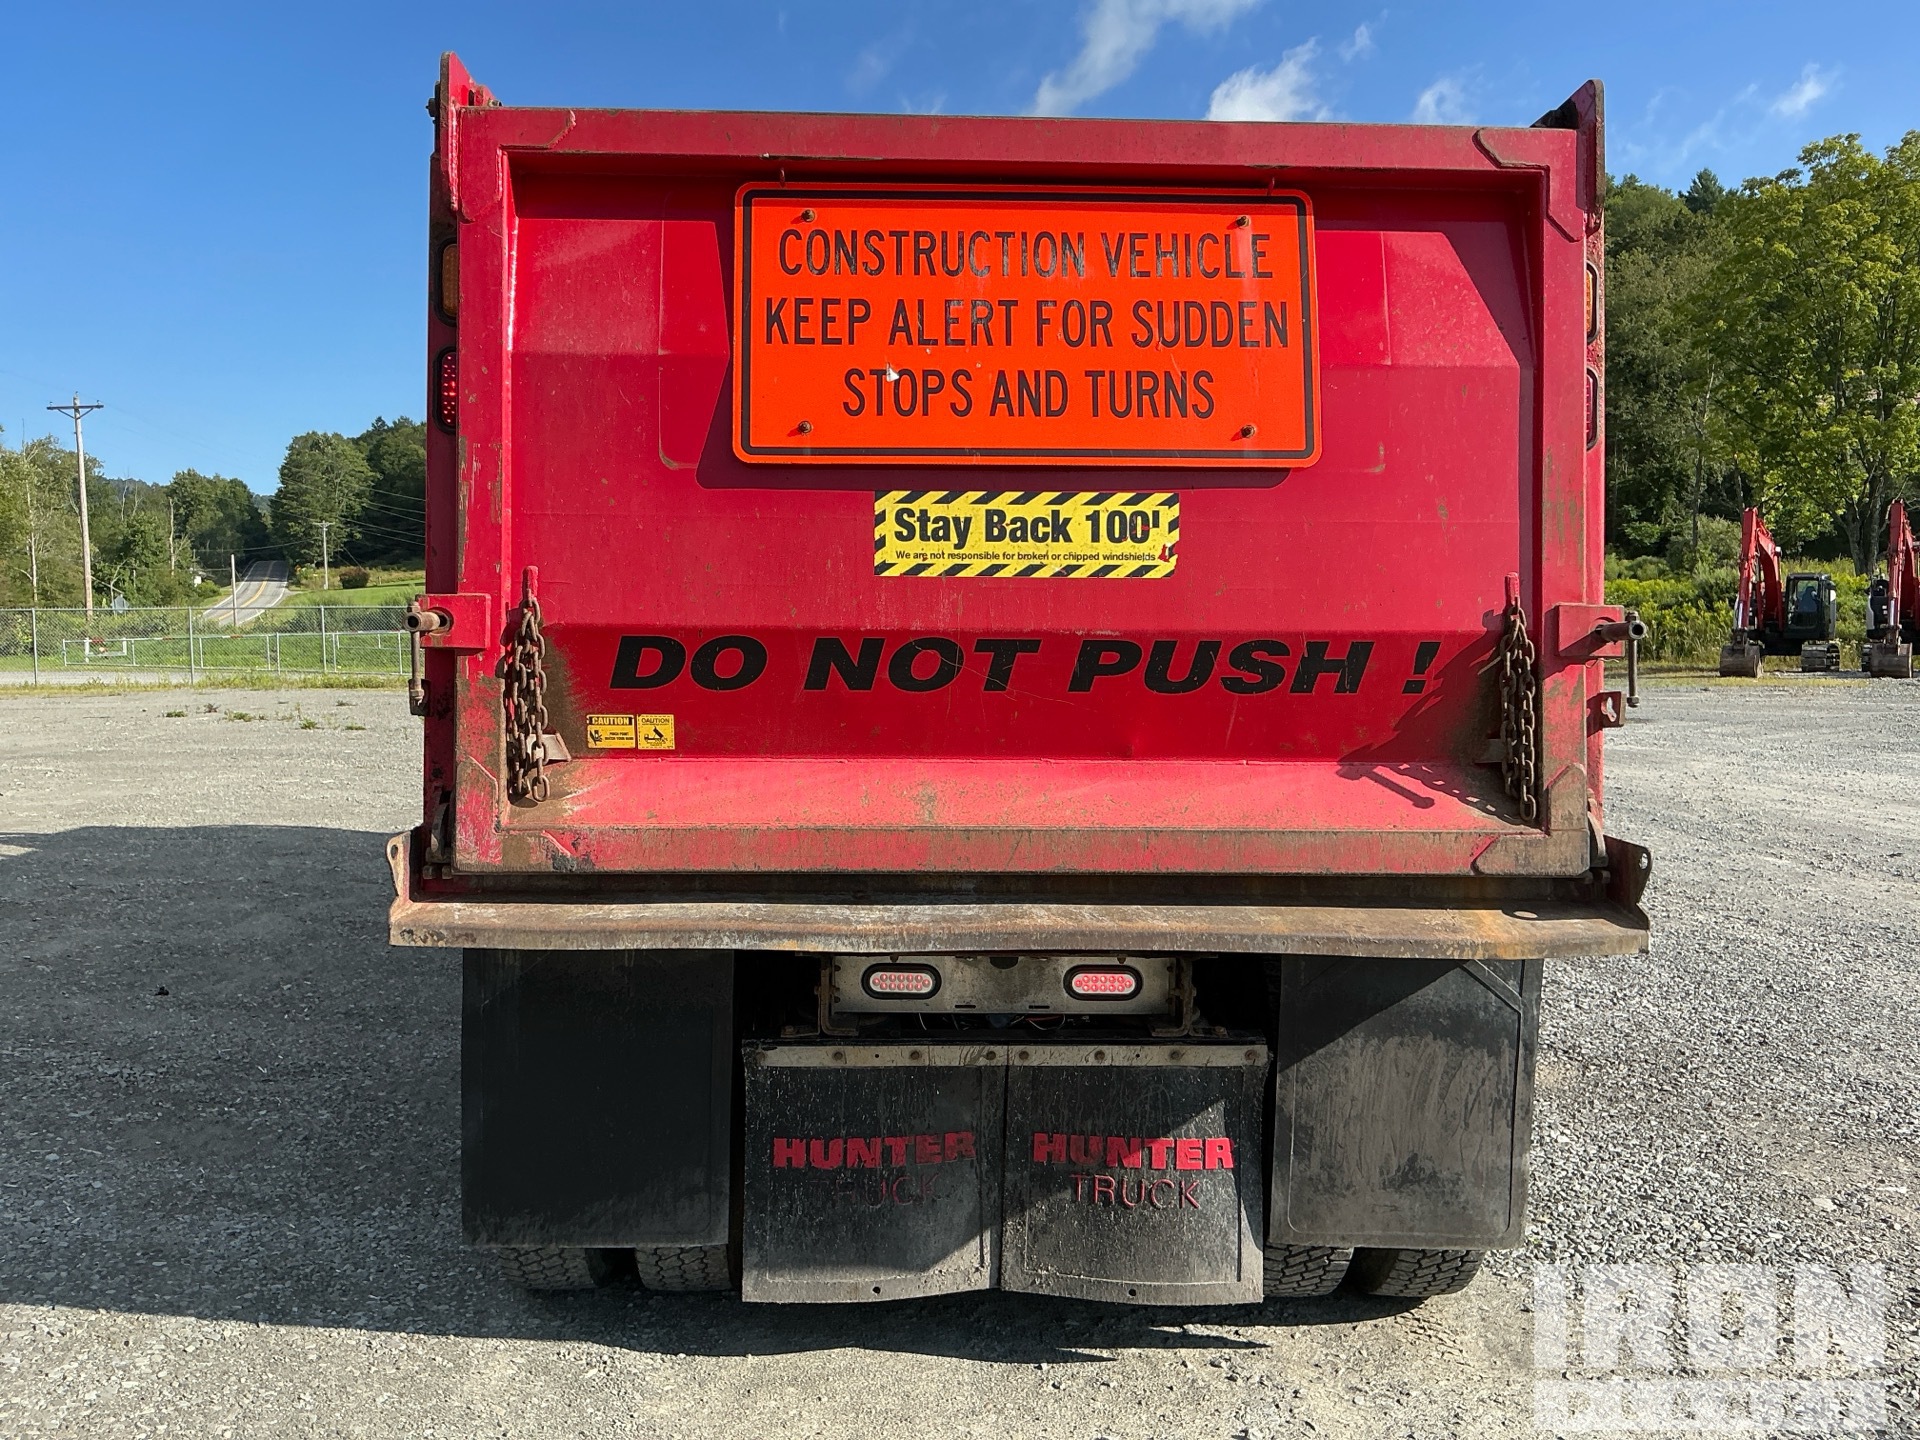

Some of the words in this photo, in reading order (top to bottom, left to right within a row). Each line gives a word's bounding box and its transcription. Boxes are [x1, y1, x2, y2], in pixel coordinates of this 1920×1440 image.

[779, 228, 1085, 278] CONSTRUCTION
[1101, 232, 1274, 279] VEHICLE
[765, 297, 872, 346] KEEP
[888, 298, 1018, 347] ALERT
[1036, 299, 1113, 348] FOR
[1131, 300, 1289, 349] SUDDEN
[843, 367, 973, 418] STOPS
[990, 369, 1068, 418] AND
[1084, 370, 1214, 419] TURNS
[894, 507, 973, 550] Stay
[985, 508, 1074, 544] Back
[895, 550, 911, 560] We
[913, 552, 928, 560] are
[930, 550, 945, 560] not
[947, 551, 1000, 561] responsible
[1002, 551, 1015, 560] for
[1017, 551, 1049, 560] broken
[1063, 552, 1100, 562] chipped
[1102, 552, 1156, 561] windshields
[609, 634, 768, 691] DO
[803, 636, 1042, 692] NOT
[1067, 639, 1375, 694] PUSH
[1402, 641, 1442, 694] !
[591, 716, 629, 725] CAUTION
[773, 1131, 977, 1170] HUNTER
[1032, 1130, 1234, 1171] HUNTER
[1069, 1173, 1201, 1211] TRUCK
